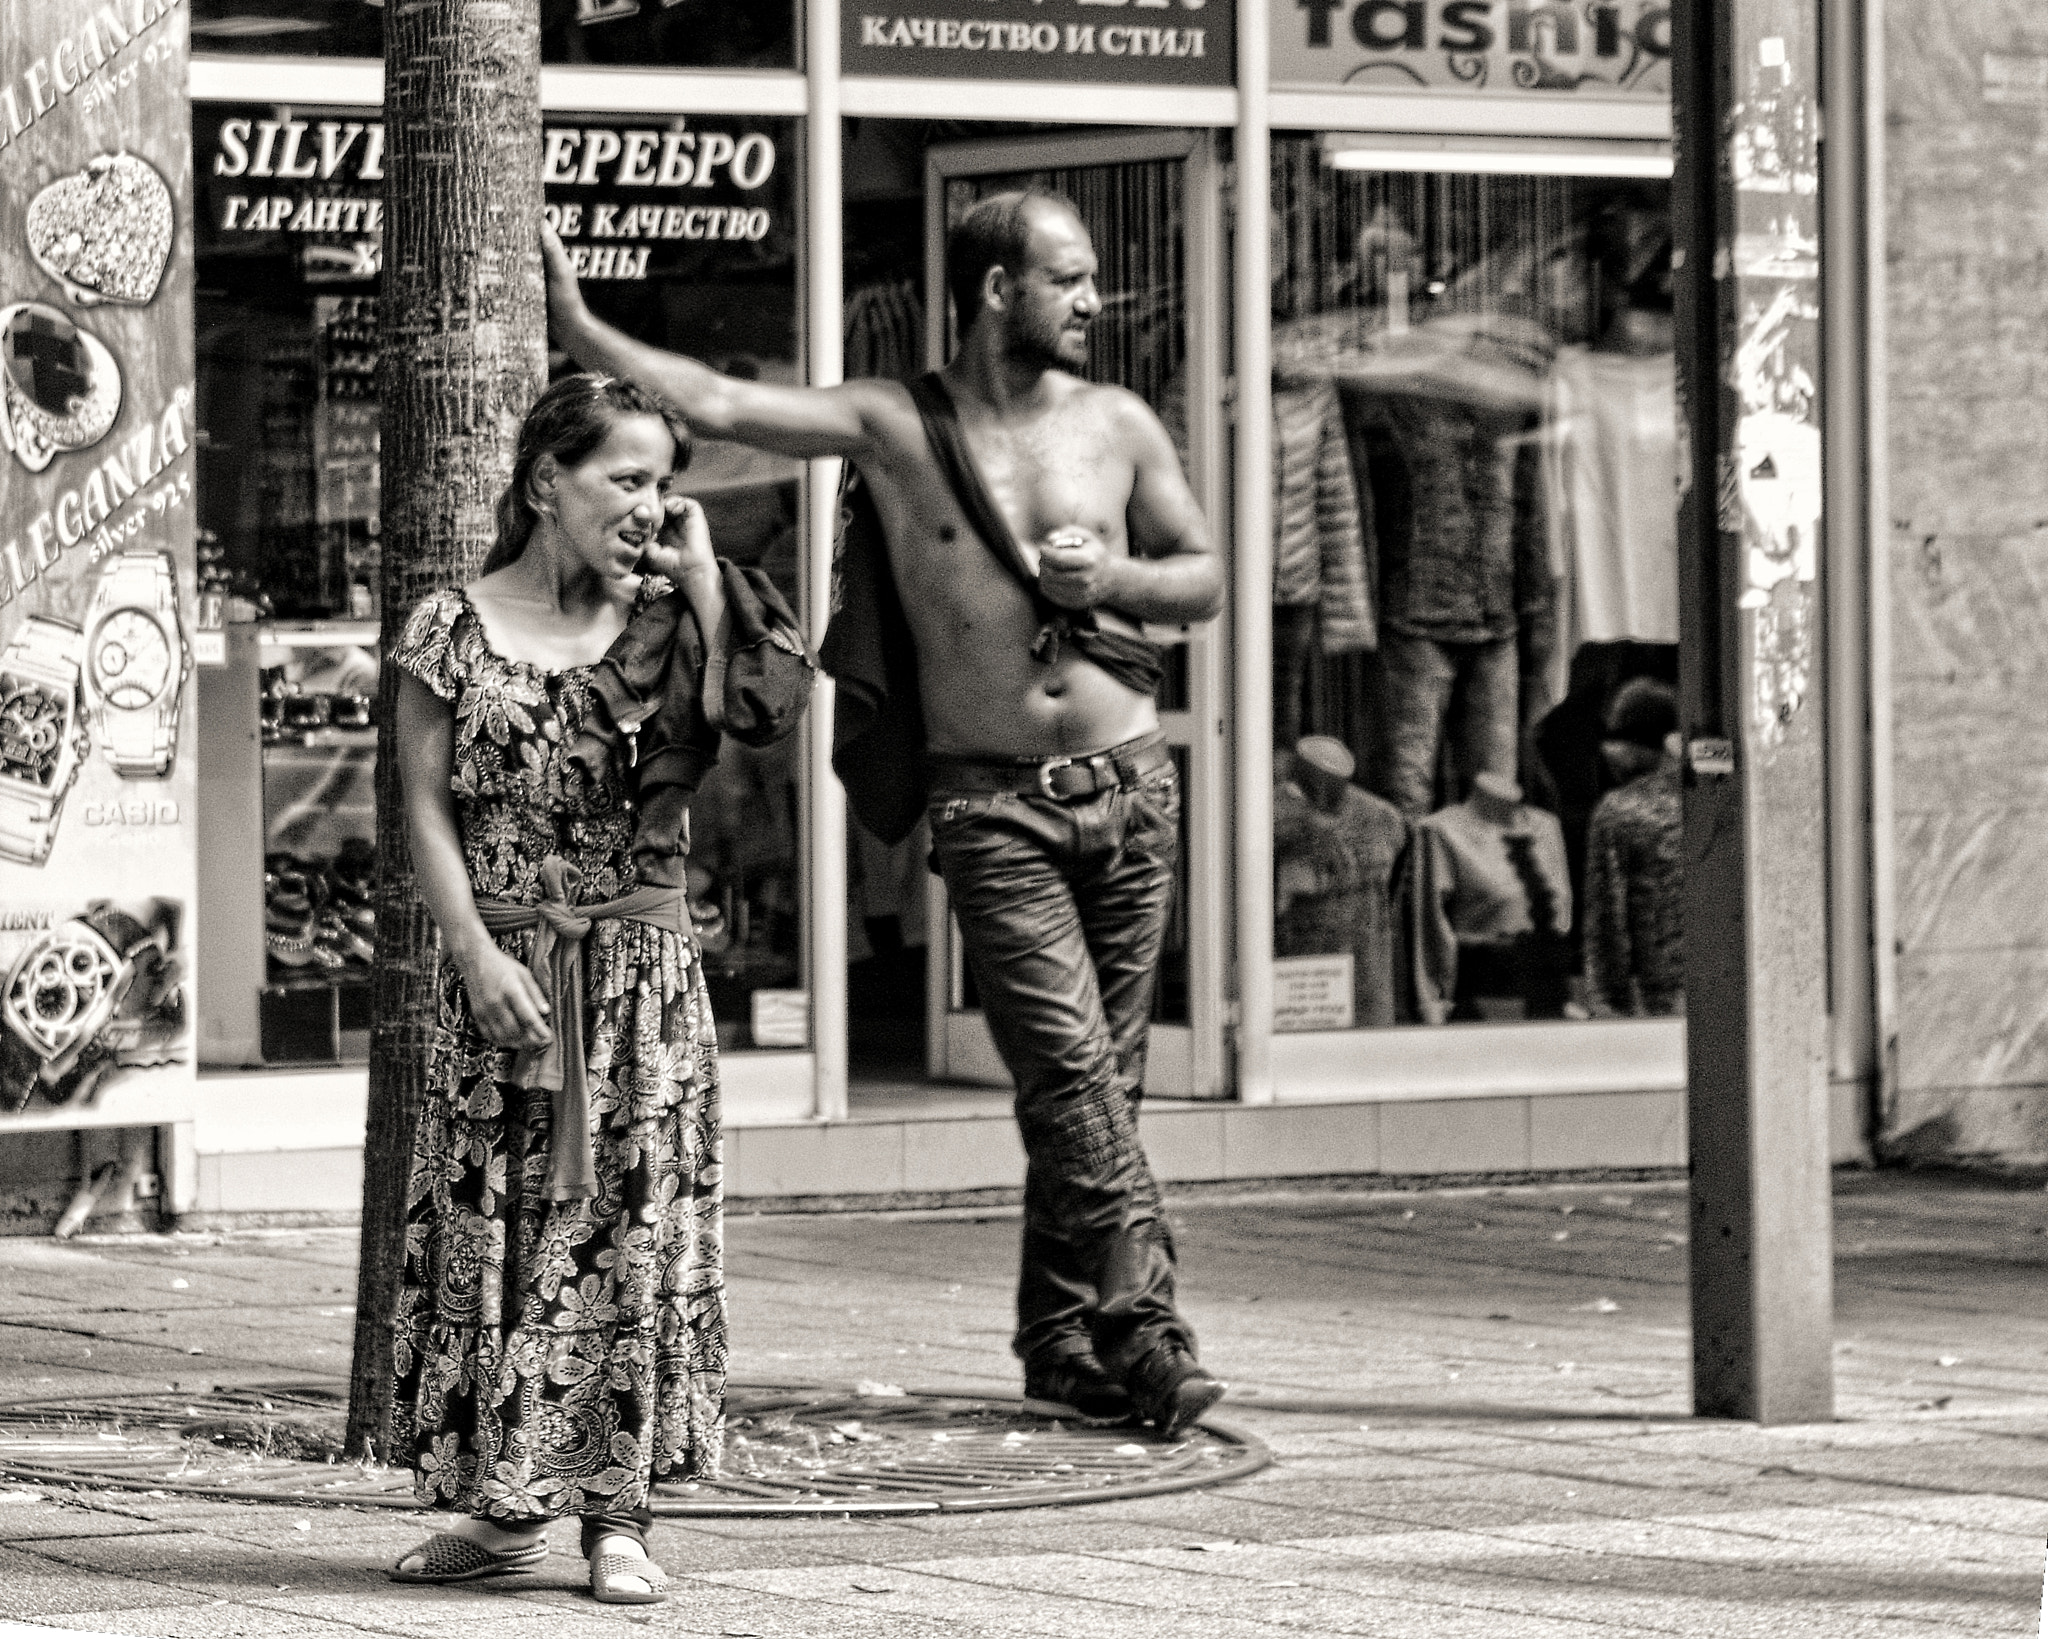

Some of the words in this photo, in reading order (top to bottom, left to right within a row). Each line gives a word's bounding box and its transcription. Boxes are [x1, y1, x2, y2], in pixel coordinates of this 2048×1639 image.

[861, 15, 1060, 52] КАЧЕСТВО
[1066, 25, 1097, 54] И
[1101, 26, 1207, 57] СТИЛ
[0, 0, 182, 150] LEGANZ
[82, 60, 139, 114] silver
[542, 128, 776, 190] ЕРЕБРО
[591, 204, 771, 241] КАЧЕСТВО
[563, 245, 652, 280] ЕНЫ
[0, 403, 190, 607] LEGANZA
[89, 506, 147, 564] silver
[152, 471, 191, 518] 925
[83, 799, 181, 826] CASIO
